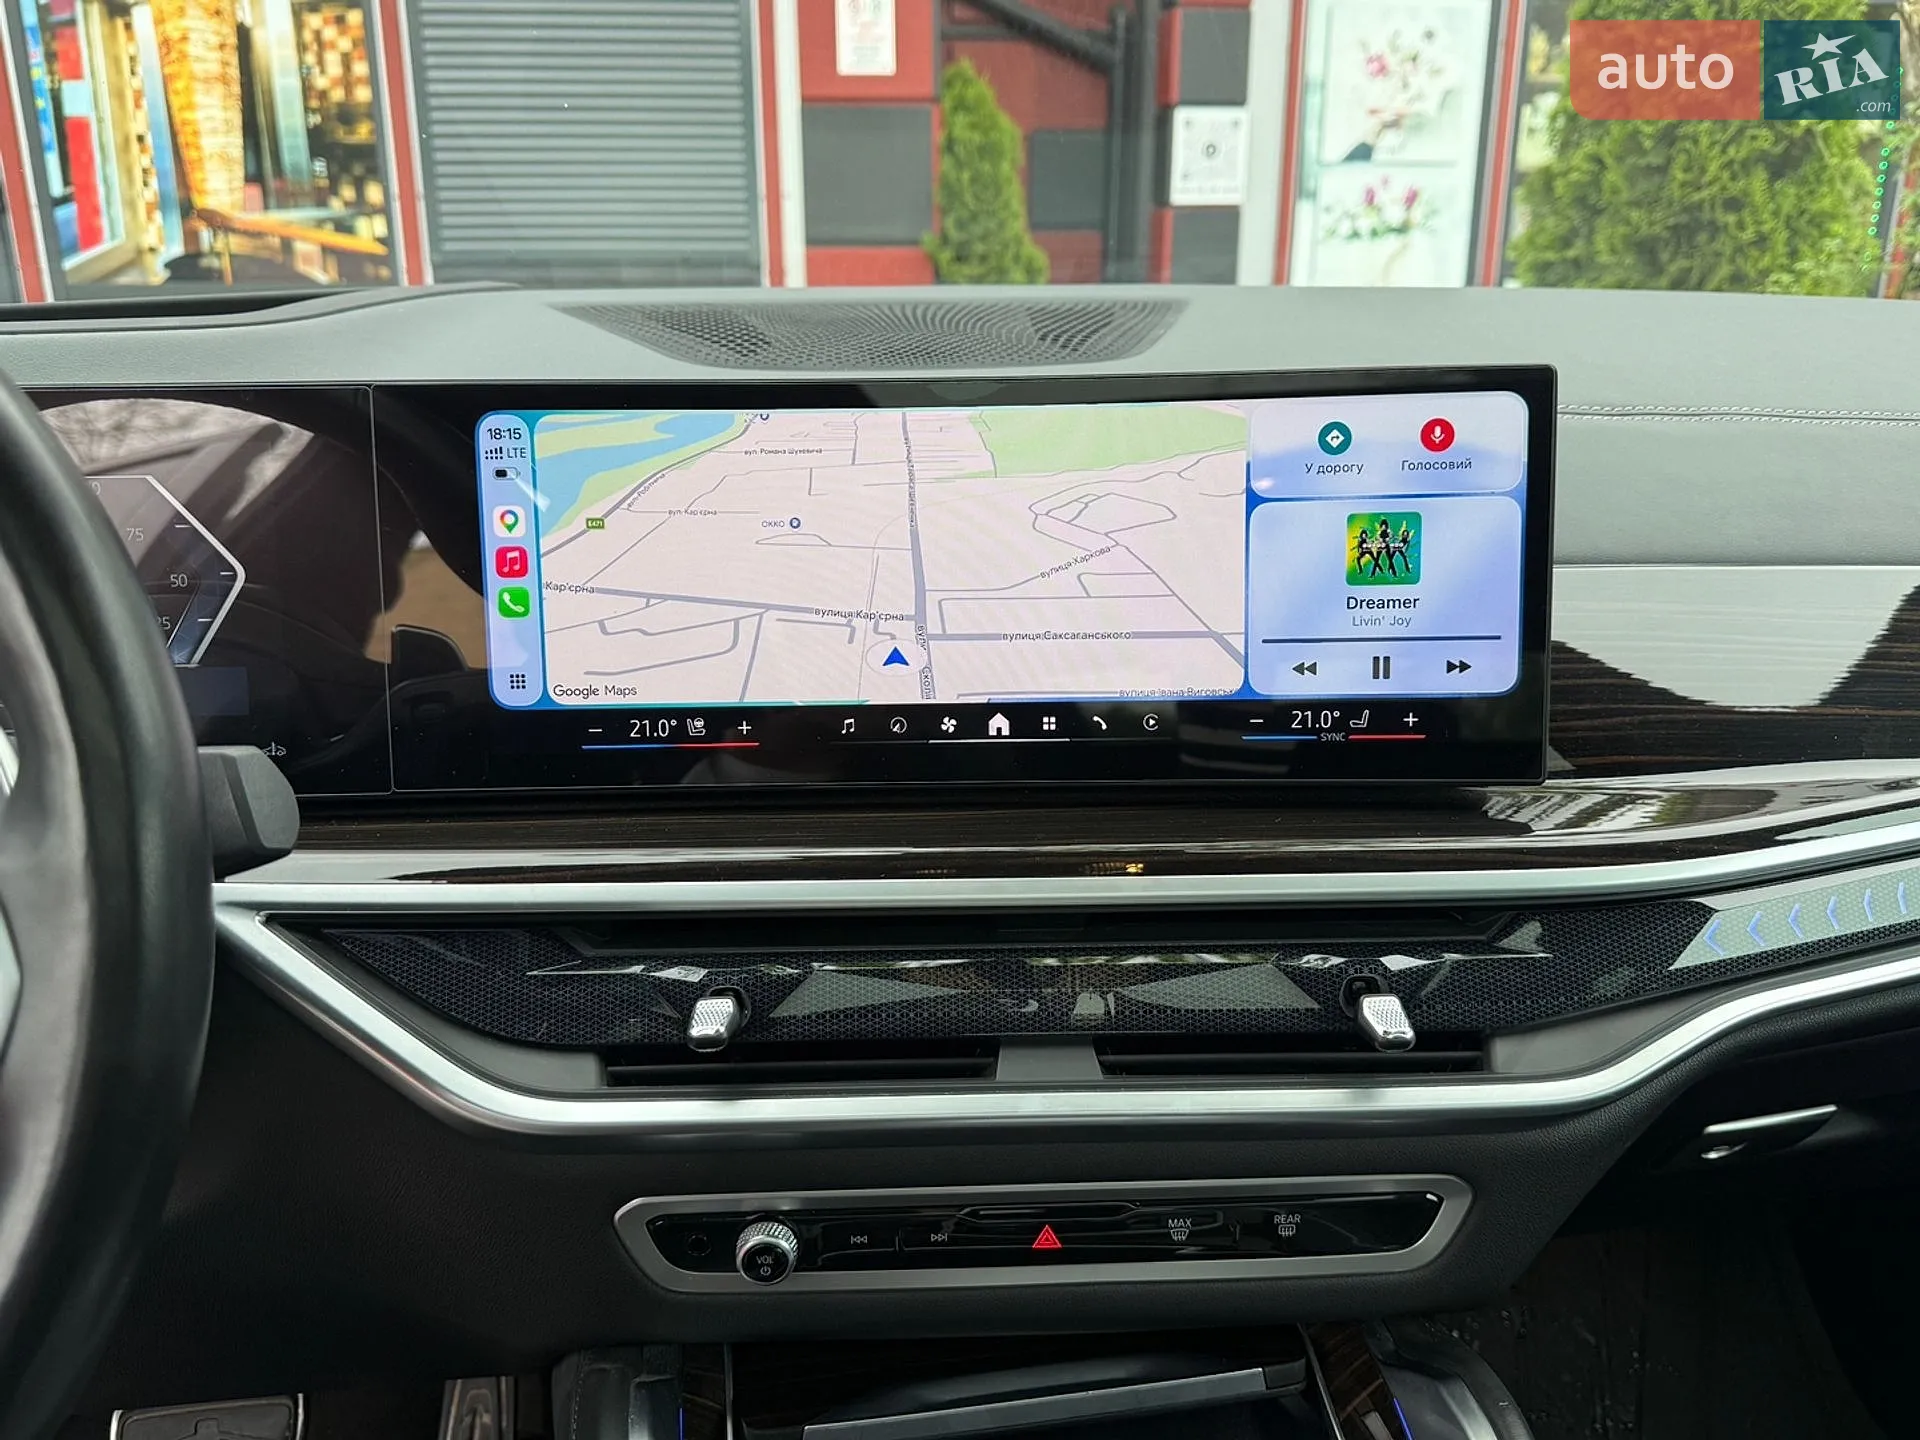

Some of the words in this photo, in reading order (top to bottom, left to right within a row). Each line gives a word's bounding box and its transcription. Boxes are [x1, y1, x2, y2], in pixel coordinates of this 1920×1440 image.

[487, 427, 522, 440] 18:15
[506, 447, 527, 459] LTE
[1305, 463, 1313, 474] У
[1316, 463, 1364, 475] дорогу
[1401, 458, 1472, 471] Голосовий
[126, 528, 144, 541] 75
[1040, 563, 1072, 579] вулиця
[1073, 545, 1111, 566] Харкова
[170, 574, 188, 588] 50
[1346, 596, 1420, 610] Dreamer
[814, 608, 854, 618] вулиця
[1352, 615, 1385, 627] Livin'
[1390, 615, 1412, 628] Joy
[1002, 632, 1041, 642] вулиця
[1043, 630, 1132, 640] Саксаганського
[553, 684, 600, 699] Google
[604, 684, 638, 698] Maps
[1291, 710, 1341, 729] 21.0°
[629, 719, 678, 738] 21.0°
[1320, 733, 1346, 742] SYNC
[1168, 1218, 1192, 1228] MAX
[1273, 1214, 1302, 1224] REAR
[756, 1255, 775, 1264] VOL
